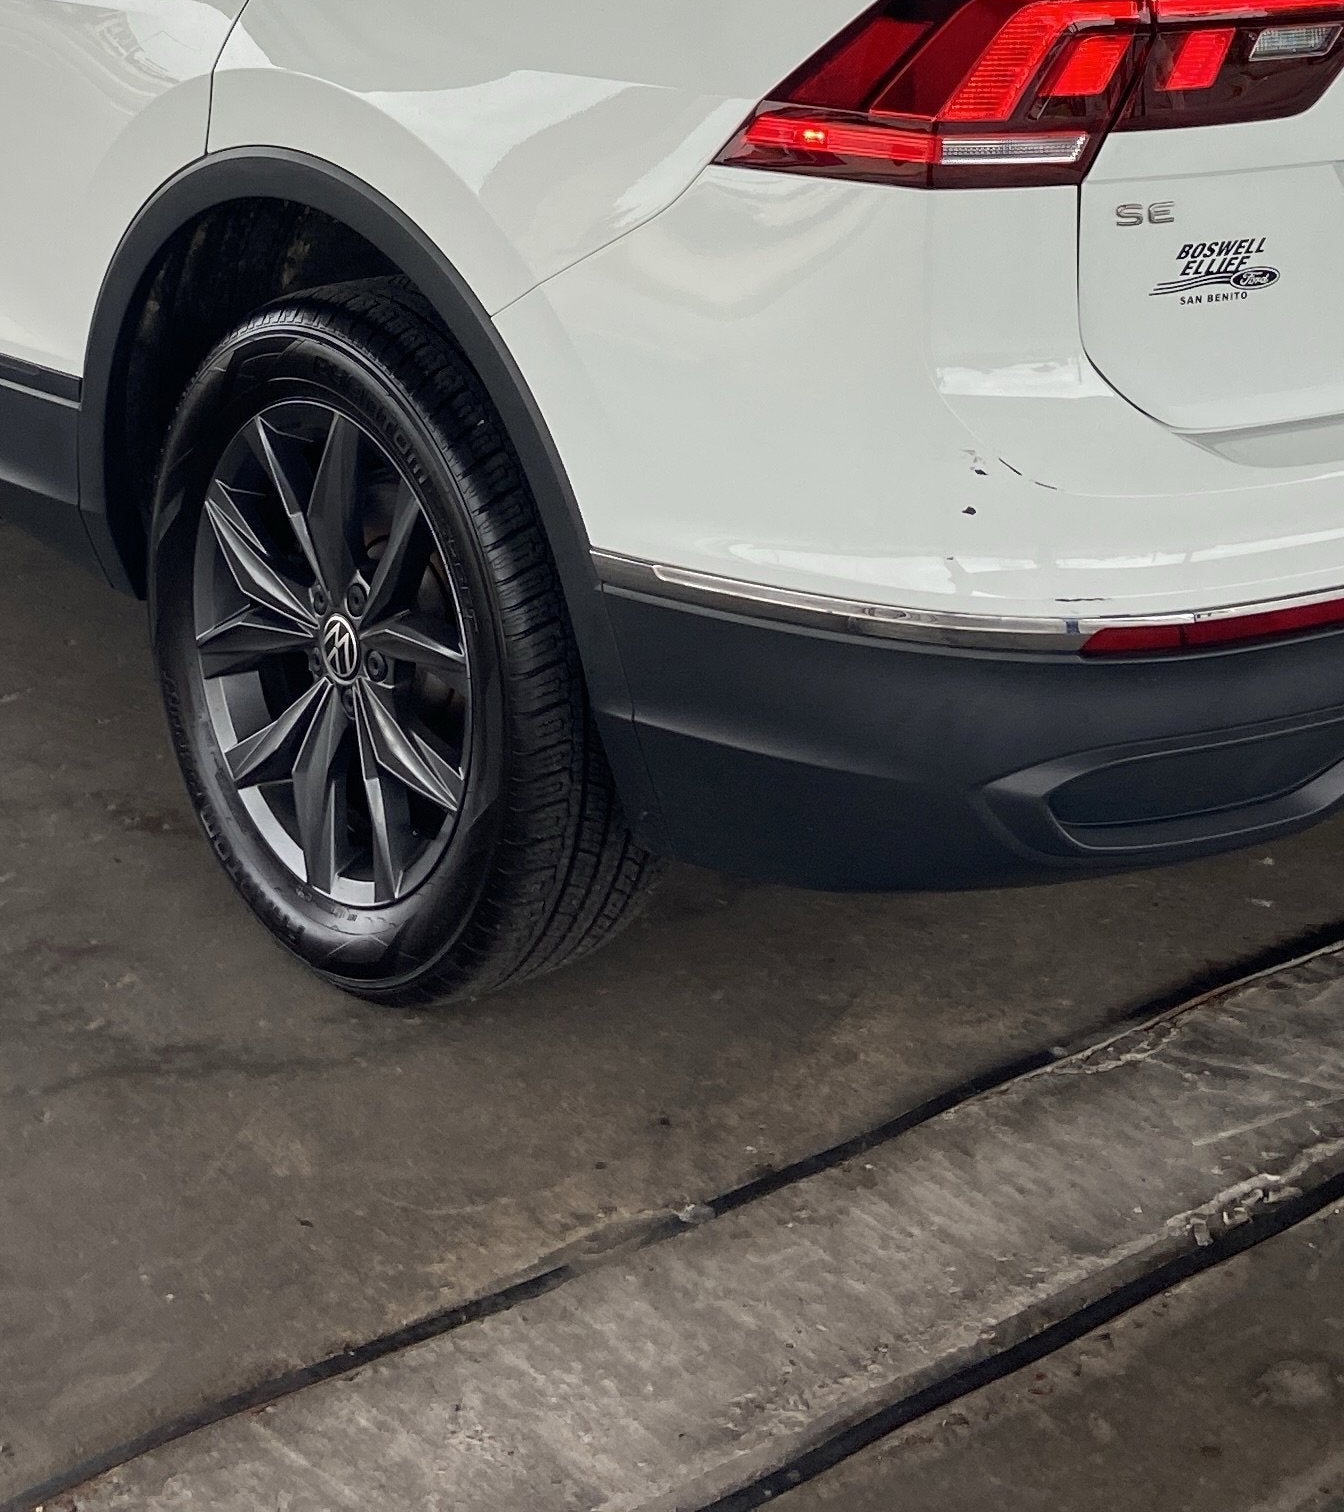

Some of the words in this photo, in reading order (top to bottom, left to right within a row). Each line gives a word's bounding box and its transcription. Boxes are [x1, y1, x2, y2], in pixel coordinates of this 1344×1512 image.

[1115, 200, 1176, 227] SE
[1176, 237, 1267, 260] BOSWELL
[1179, 255, 1252, 277] ELLIFF
[1238, 270, 1272, 286] Ford
[1179, 296, 1203, 306] SAN
[1206, 291, 1249, 304] BENITO
